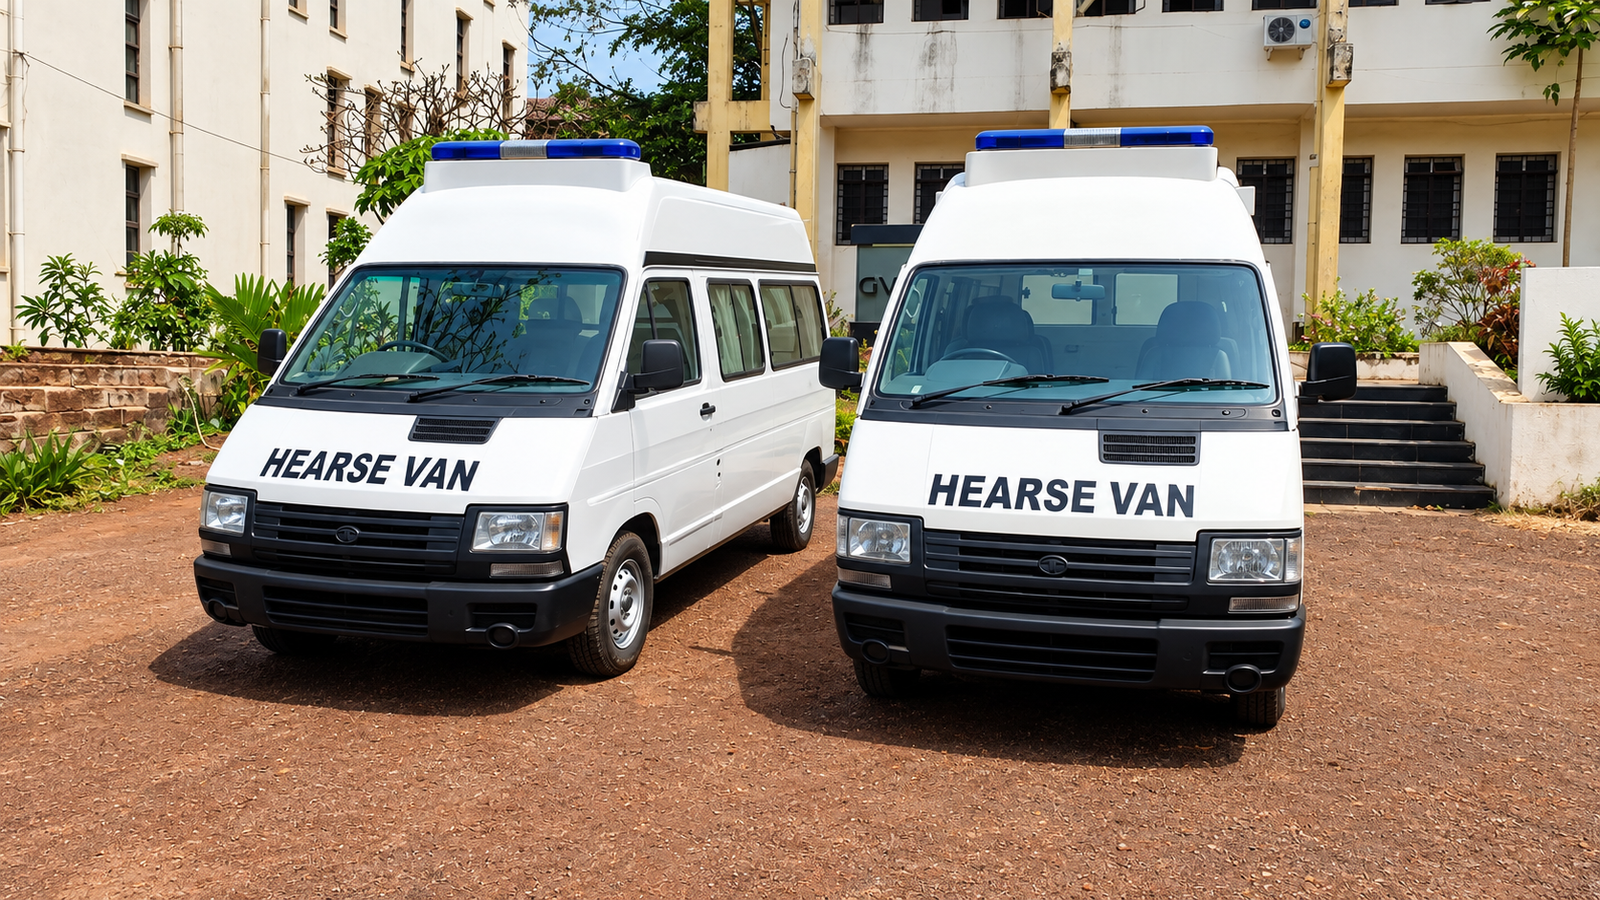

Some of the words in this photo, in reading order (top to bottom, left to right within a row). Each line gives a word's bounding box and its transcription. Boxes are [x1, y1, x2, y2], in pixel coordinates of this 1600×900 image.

[260, 448, 396, 484] HEARSE
[404, 456, 480, 491] VAN
[928, 474, 1096, 513] HEARSE
[1110, 482, 1194, 517] VAN
